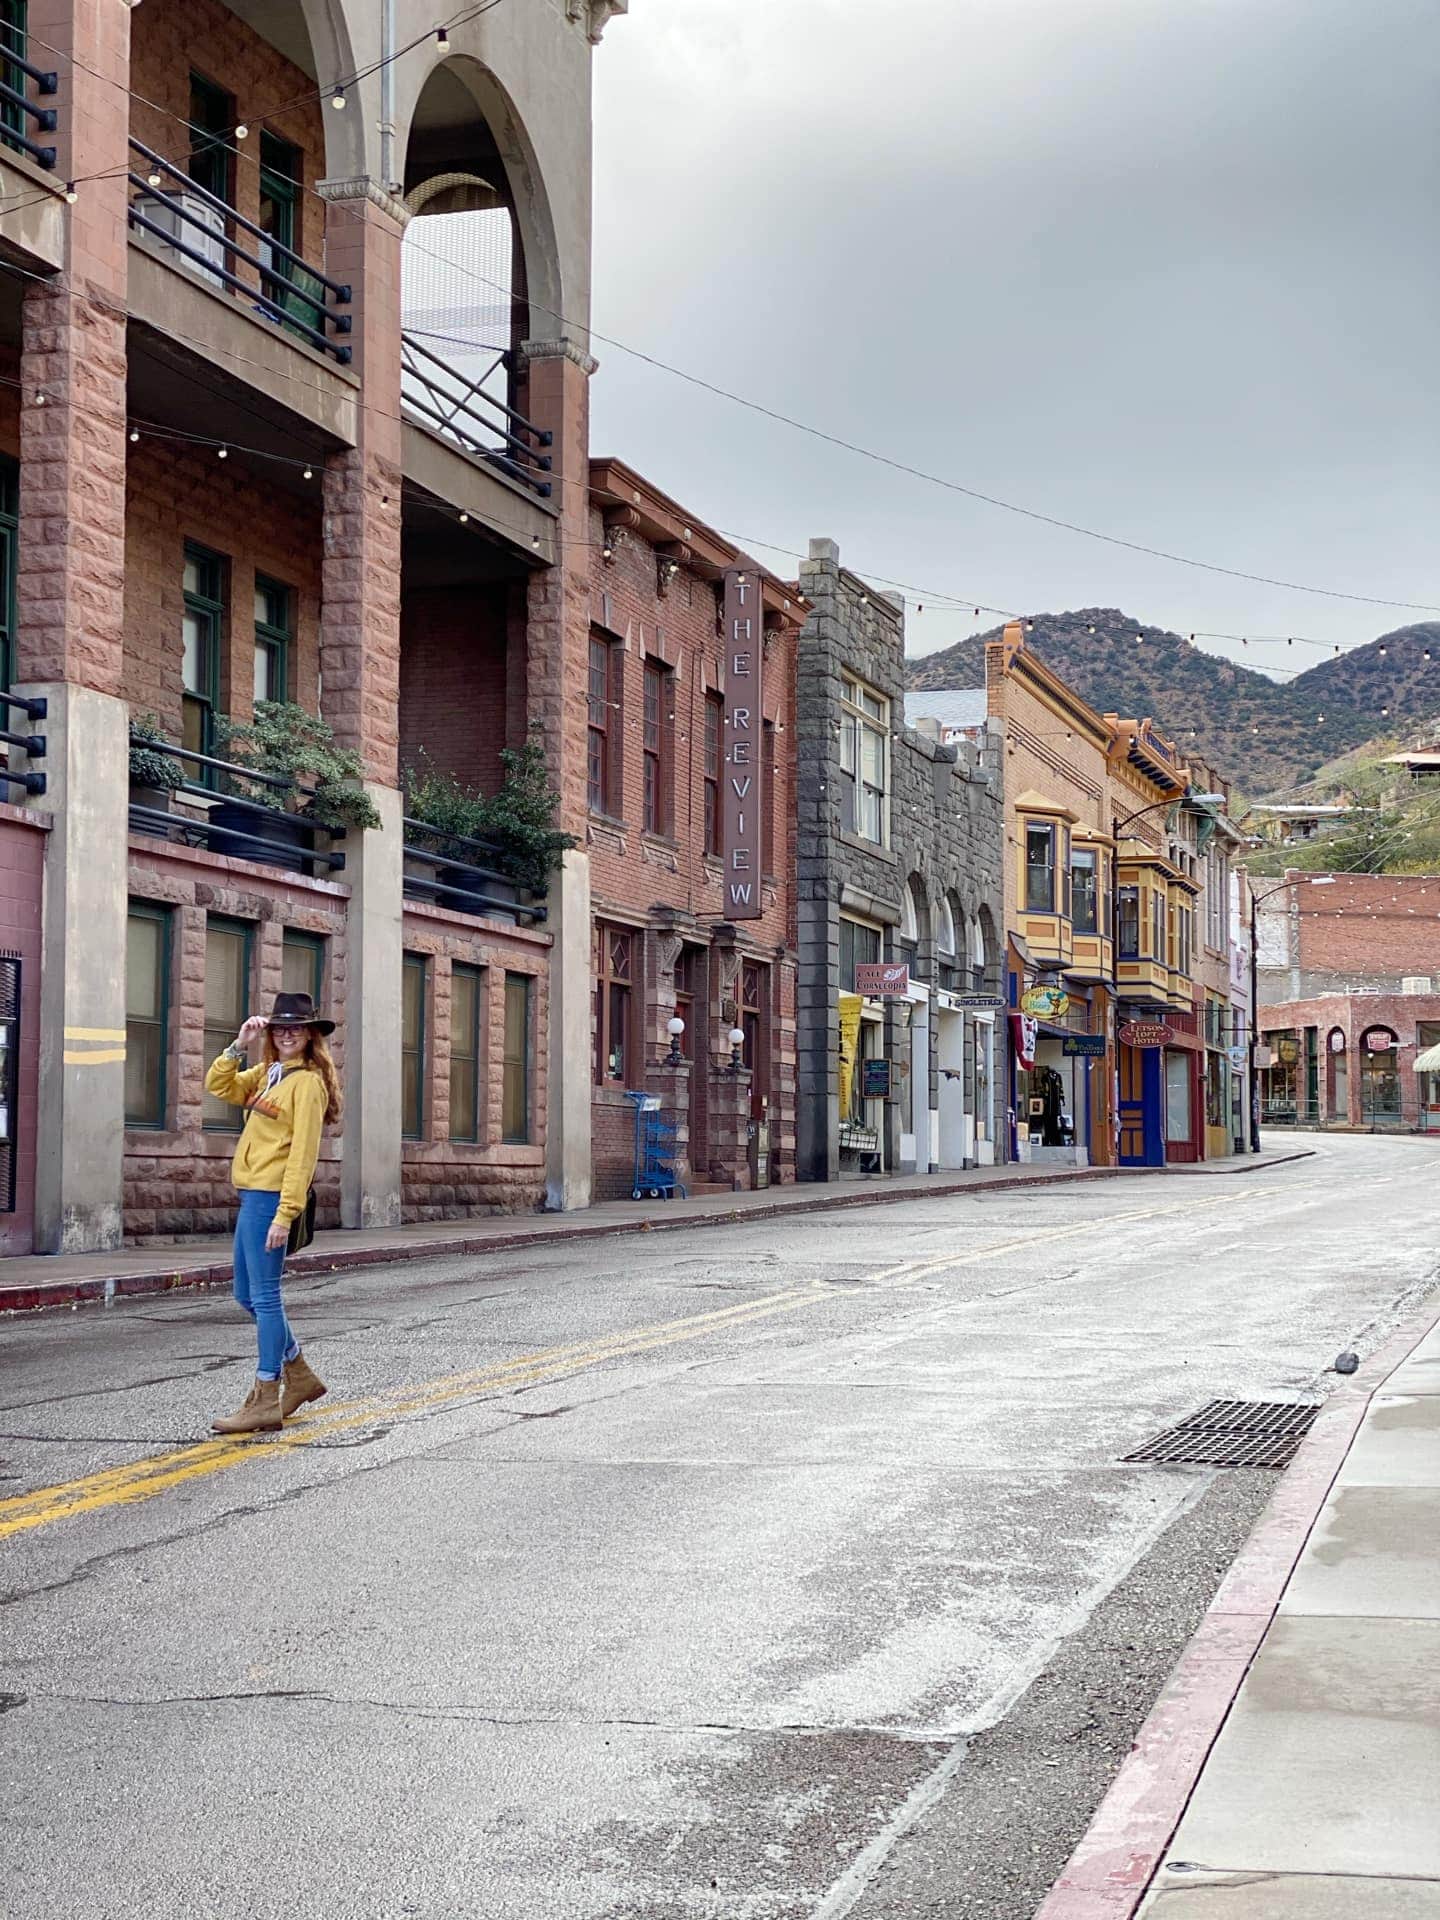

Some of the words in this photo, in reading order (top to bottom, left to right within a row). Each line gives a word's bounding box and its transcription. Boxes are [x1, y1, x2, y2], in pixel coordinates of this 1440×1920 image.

[732, 584, 751, 675] THE
[730, 708, 751, 905] REVIEW
[1133, 1037, 1161, 1045] HOTEL
